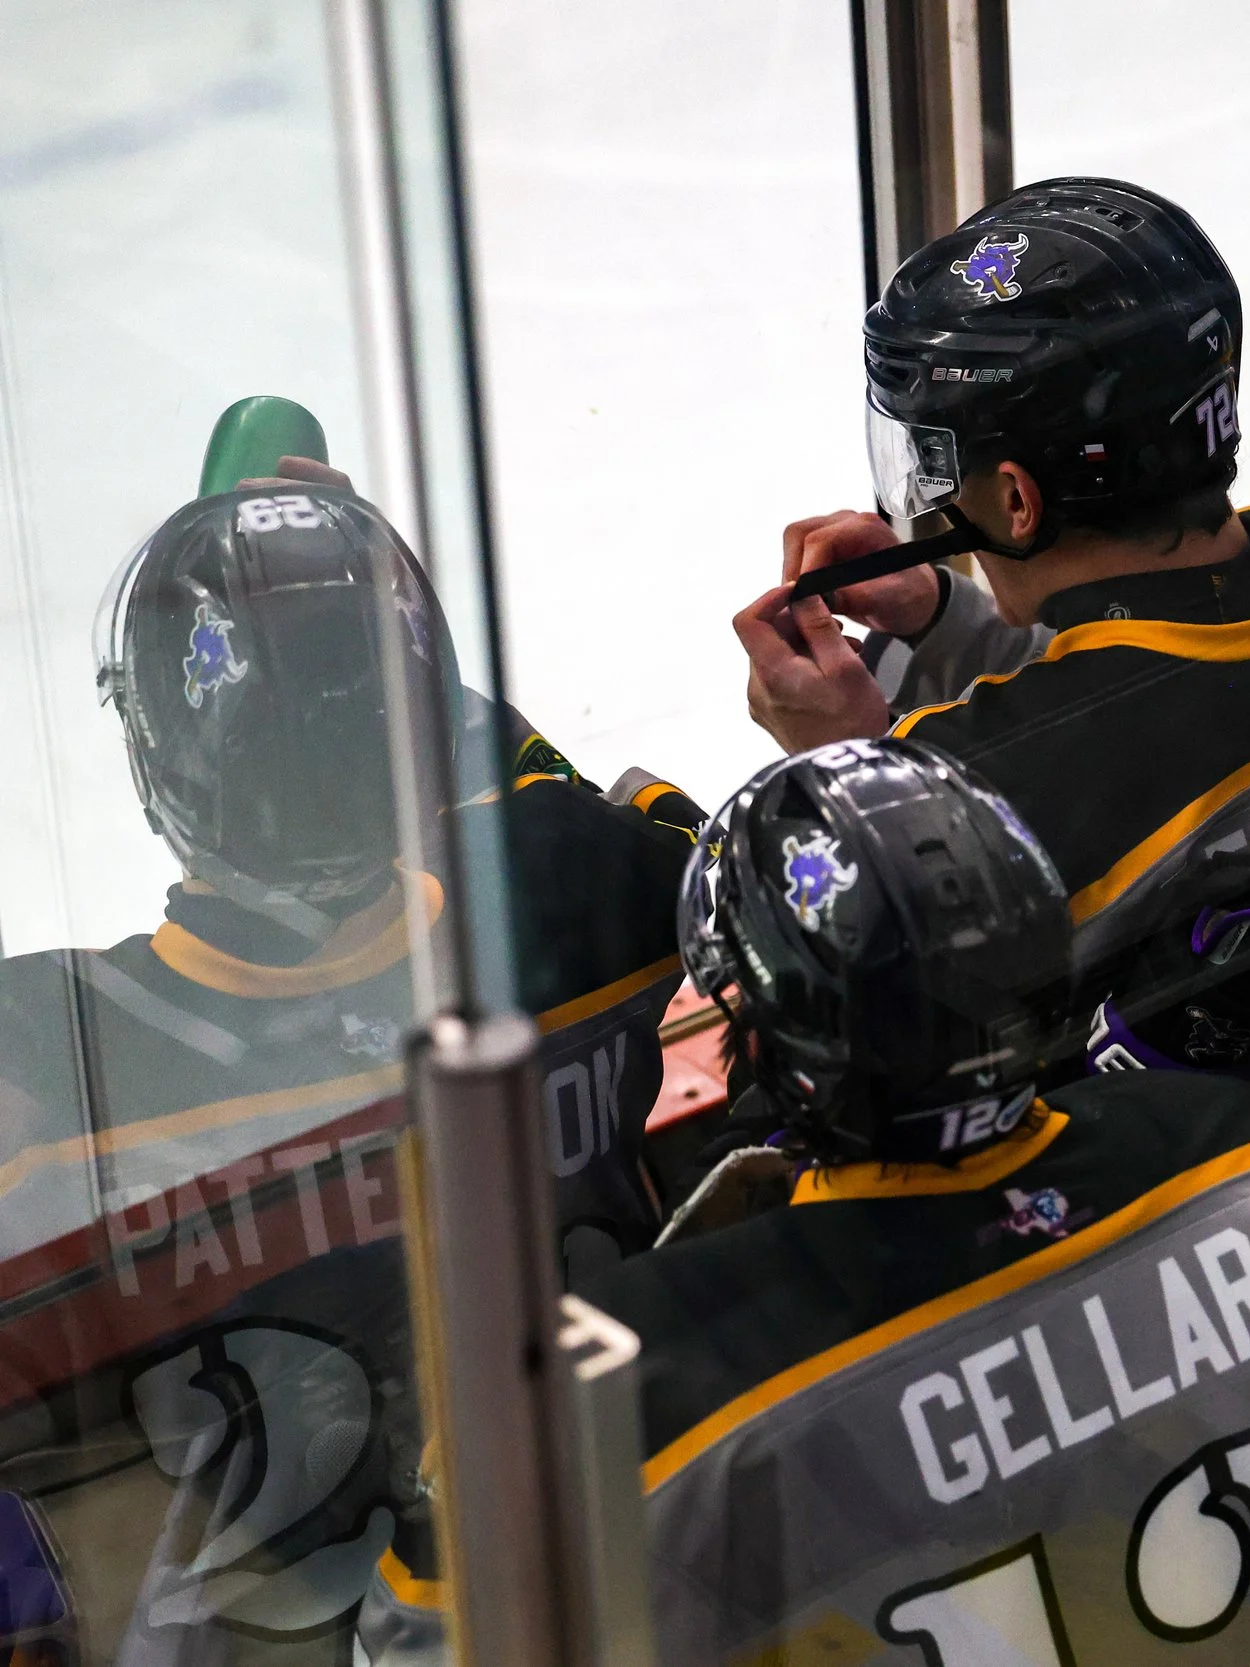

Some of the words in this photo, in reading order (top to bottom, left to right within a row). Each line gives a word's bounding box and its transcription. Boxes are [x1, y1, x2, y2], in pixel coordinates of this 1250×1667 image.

[931, 367, 1014, 383] BAUER
[1195, 383, 1235, 458] 72
[918, 477, 953, 488] BAUER
[940, 1099, 1001, 1150] 12
